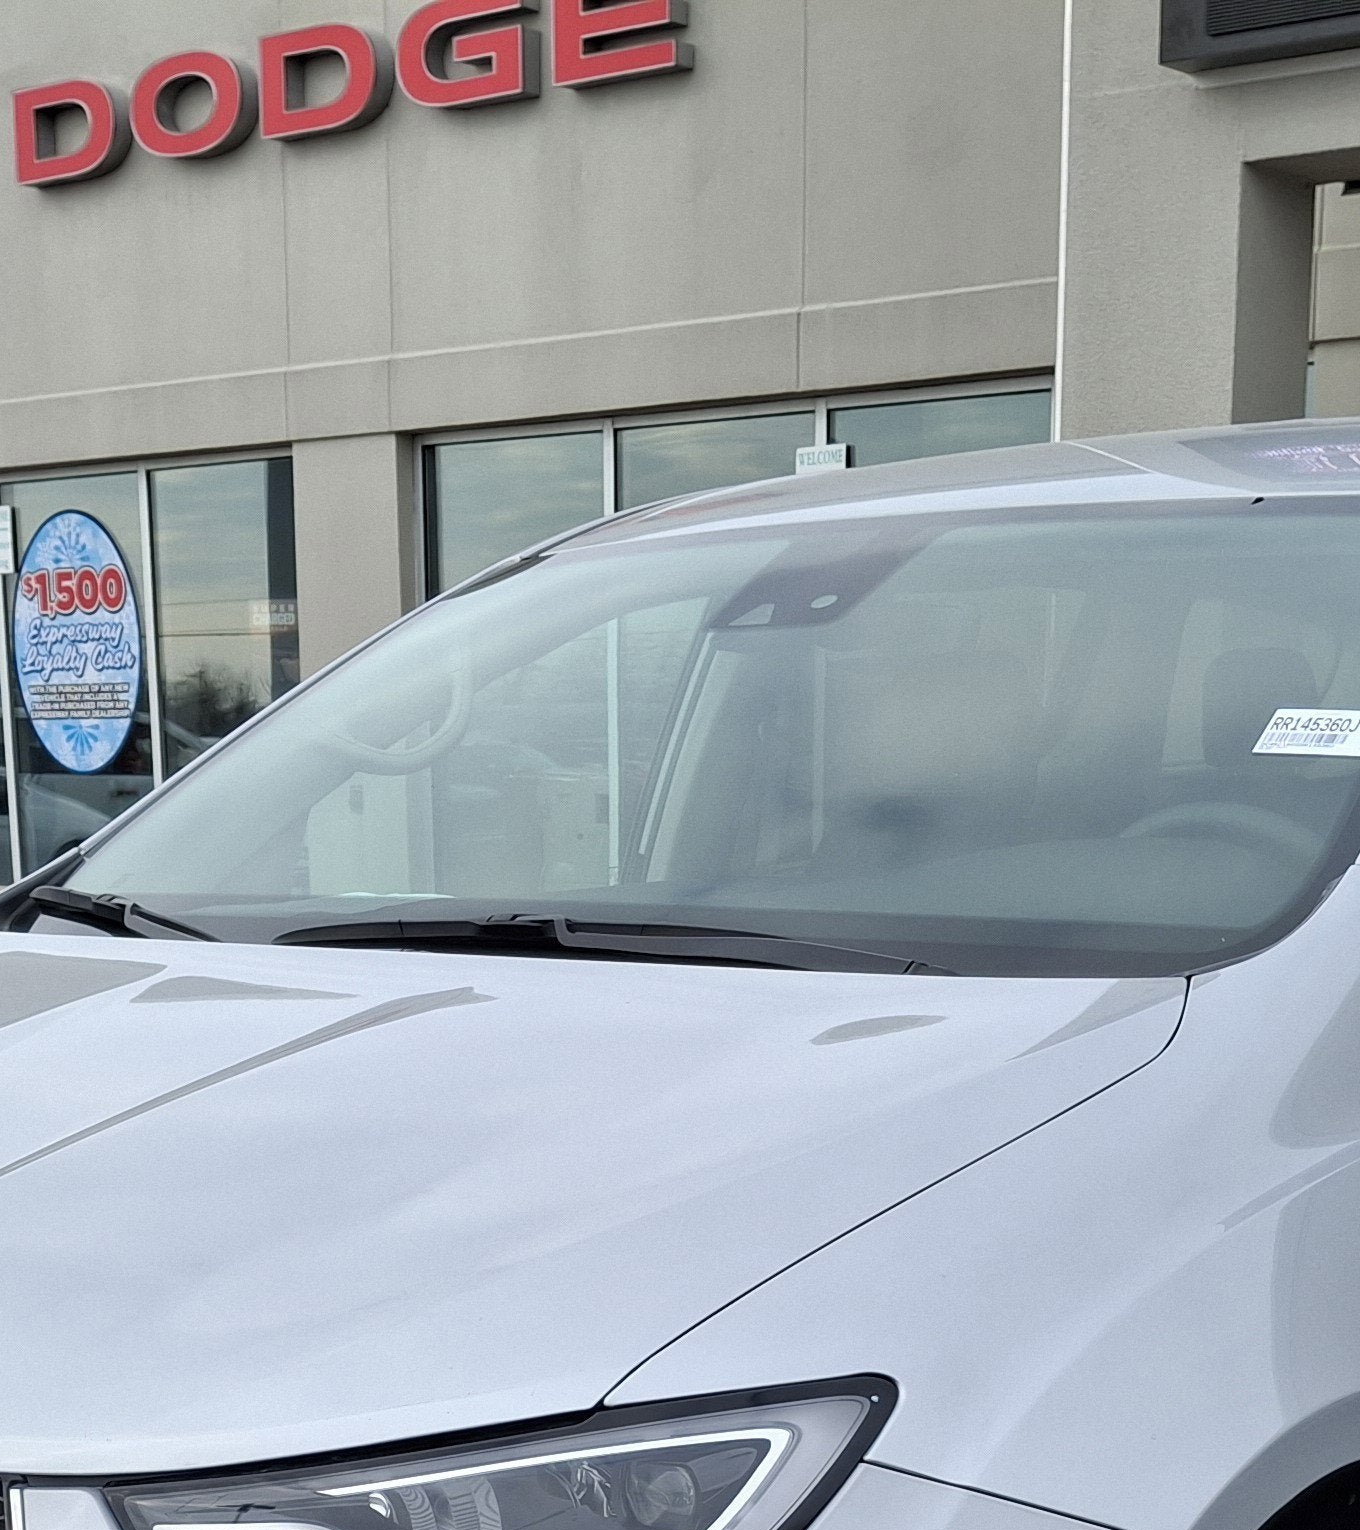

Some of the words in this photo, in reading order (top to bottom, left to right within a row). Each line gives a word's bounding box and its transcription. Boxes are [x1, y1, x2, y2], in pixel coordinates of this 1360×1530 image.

[12, 0, 692, 188] DODGE
[798, 449, 844, 466] WELCOME
[22, 564, 127, 619] $1,500
[28, 617, 124, 652] Expressway
[21, 642, 87, 682] Loyalty
[91, 641, 136, 672] Cash
